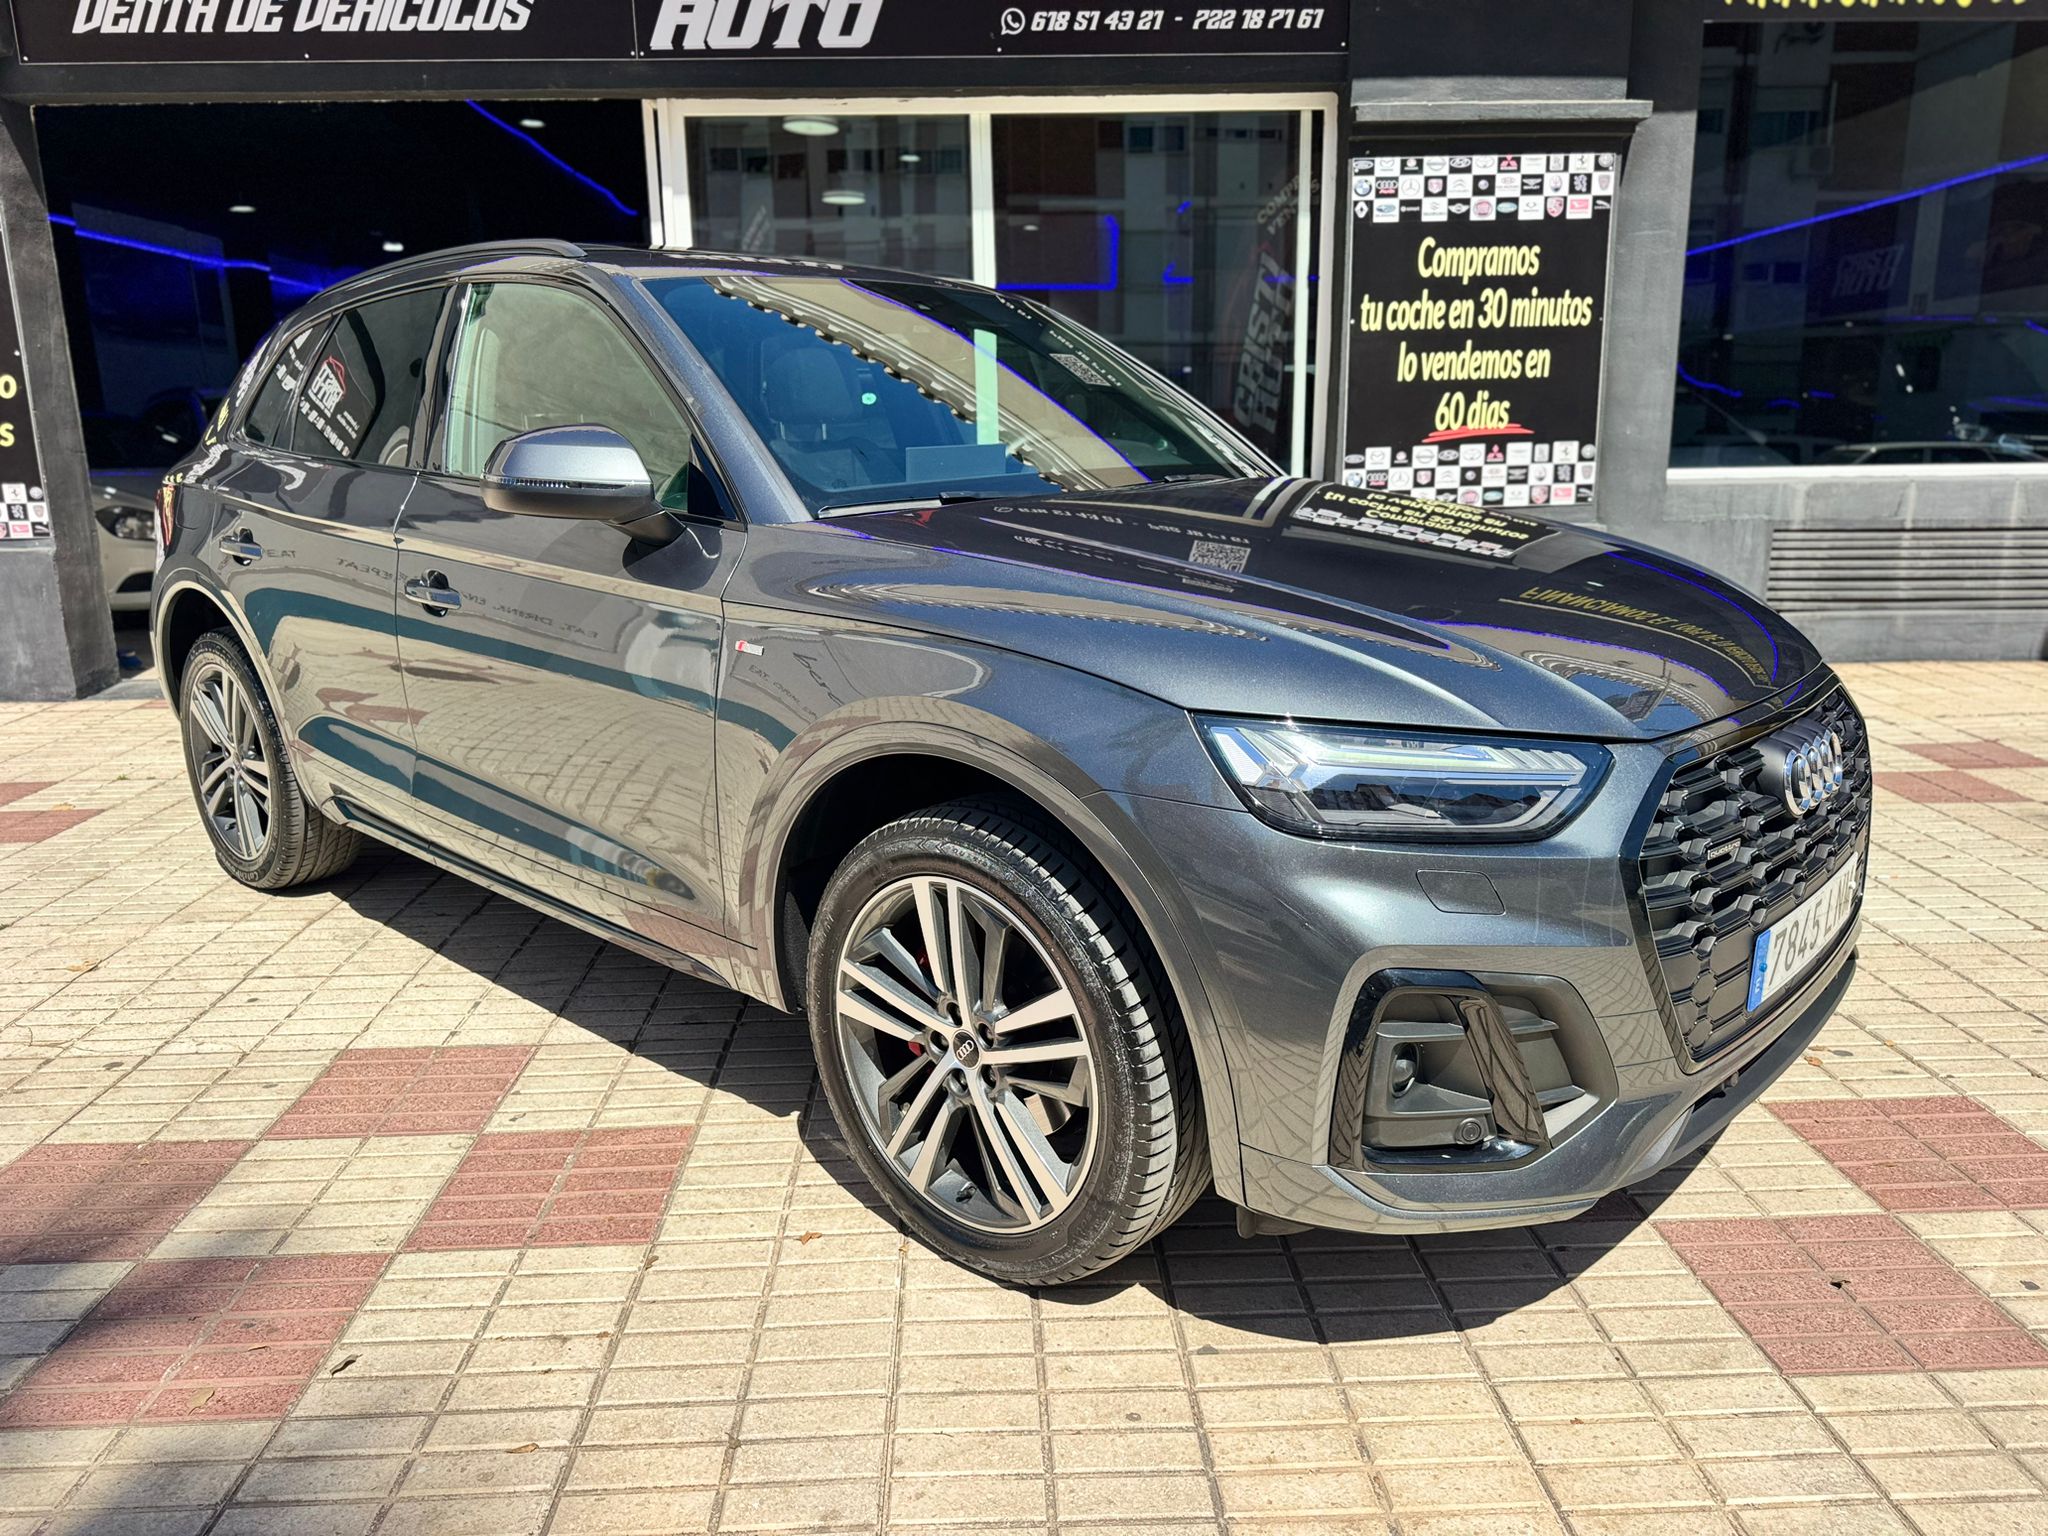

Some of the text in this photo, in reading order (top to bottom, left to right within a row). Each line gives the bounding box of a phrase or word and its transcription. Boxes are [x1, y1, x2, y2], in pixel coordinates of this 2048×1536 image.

[72, 0, 533, 33] VENTA DE VEHICULOS
[650, 0, 883, 49] AUTO
[1031, 10, 1068, 31] 618
[1073, 10, 1101, 31] 51
[1104, 10, 1135, 31] 43
[1137, 10, 1165, 31] 21
[1193, 9, 1237, 30] 722
[1241, 9, 1267, 30] 18
[1267, 8, 1296, 30] 71
[1297, 8, 1325, 29] 61
[1418, 236, 1541, 285] Compramos
[1360, 286, 1593, 331] tu coche en 30 minutos
[1397, 339, 1551, 382] lo vendemos en
[1435, 390, 1511, 432] 60 dias
[1768, 898, 1823, 987] 7845
